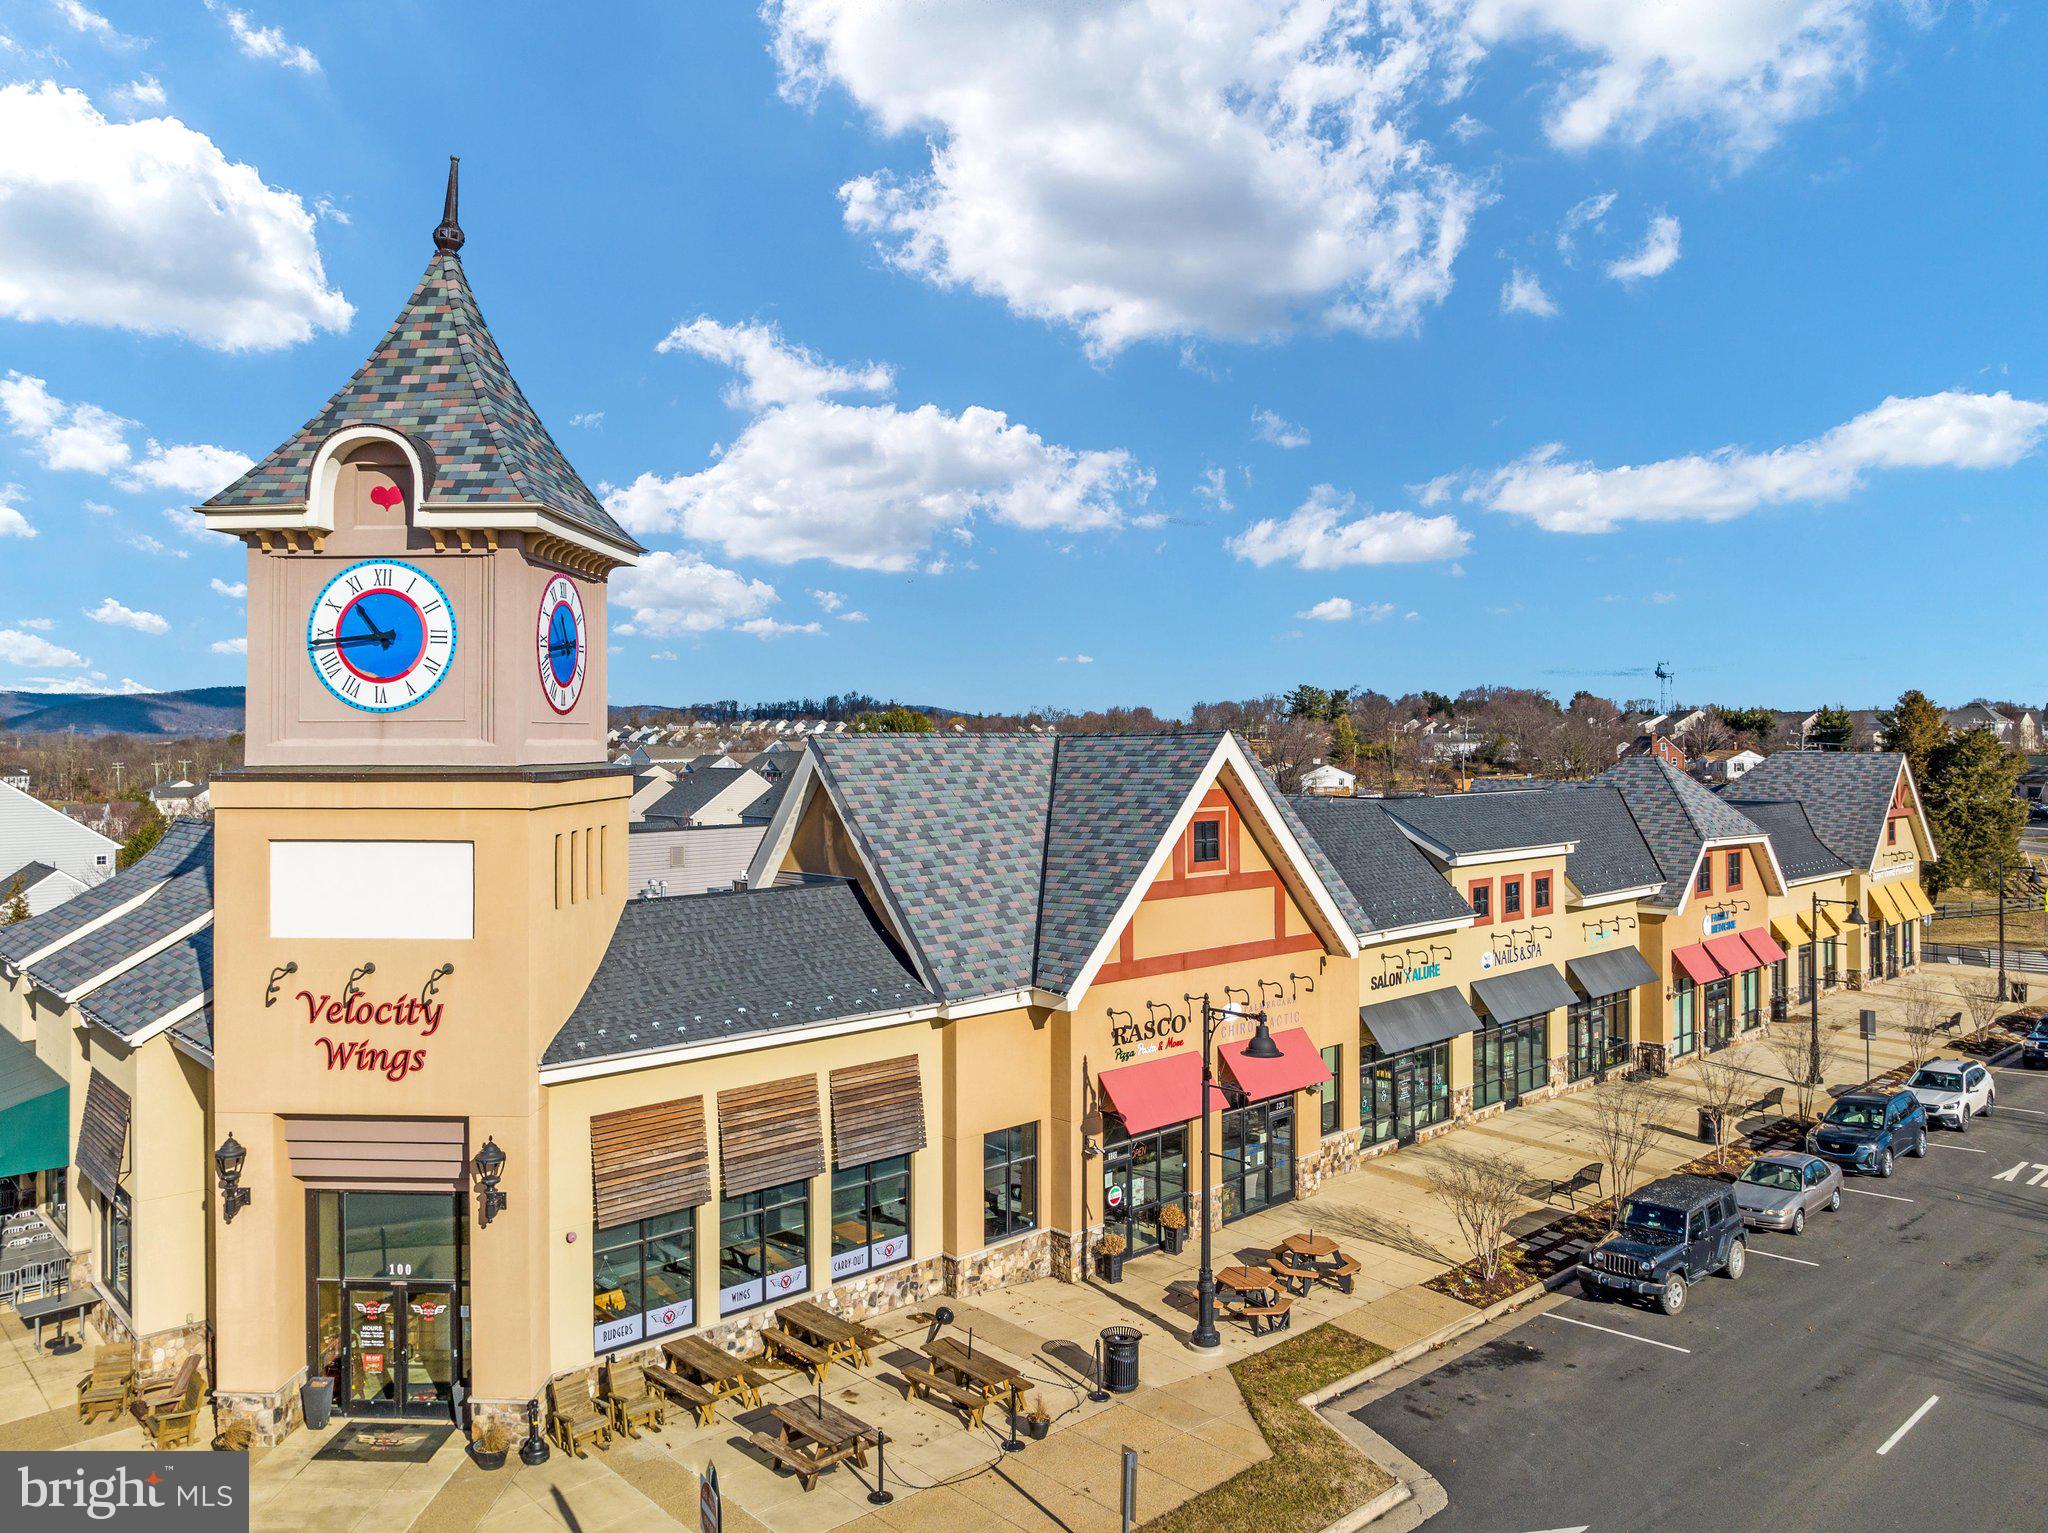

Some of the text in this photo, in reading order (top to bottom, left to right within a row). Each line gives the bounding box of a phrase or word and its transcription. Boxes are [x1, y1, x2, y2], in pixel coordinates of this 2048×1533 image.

[345, 575, 364, 596] XI
[373, 568, 392, 587] XII
[422, 599, 441, 615] II
[430, 629, 448, 645] III
[319, 651, 341, 680] VIII
[422, 656, 442, 676] IV
[341, 675, 362, 699] VII
[374, 685, 388, 704] VI
[1494, 946, 1519, 966] NAILS
[1520, 946, 1526, 961] &
[1527, 943, 1542, 959] SPA
[1371, 971, 1402, 990] SALON
[295, 990, 445, 1037] Velocity
[1112, 1014, 1187, 1047] RASCO
[1221, 1011, 1300, 1039] CHIROACTIC
[1115, 1047, 1136, 1062] Pizza
[1157, 1041, 1164, 1051] &
[1165, 1036, 1185, 1050] More
[314, 1037, 428, 1082] Wings
[389, 1263, 412, 1276] 100
[731, 1288, 751, 1303] WINGS
[602, 1323, 633, 1342] BURGERS
